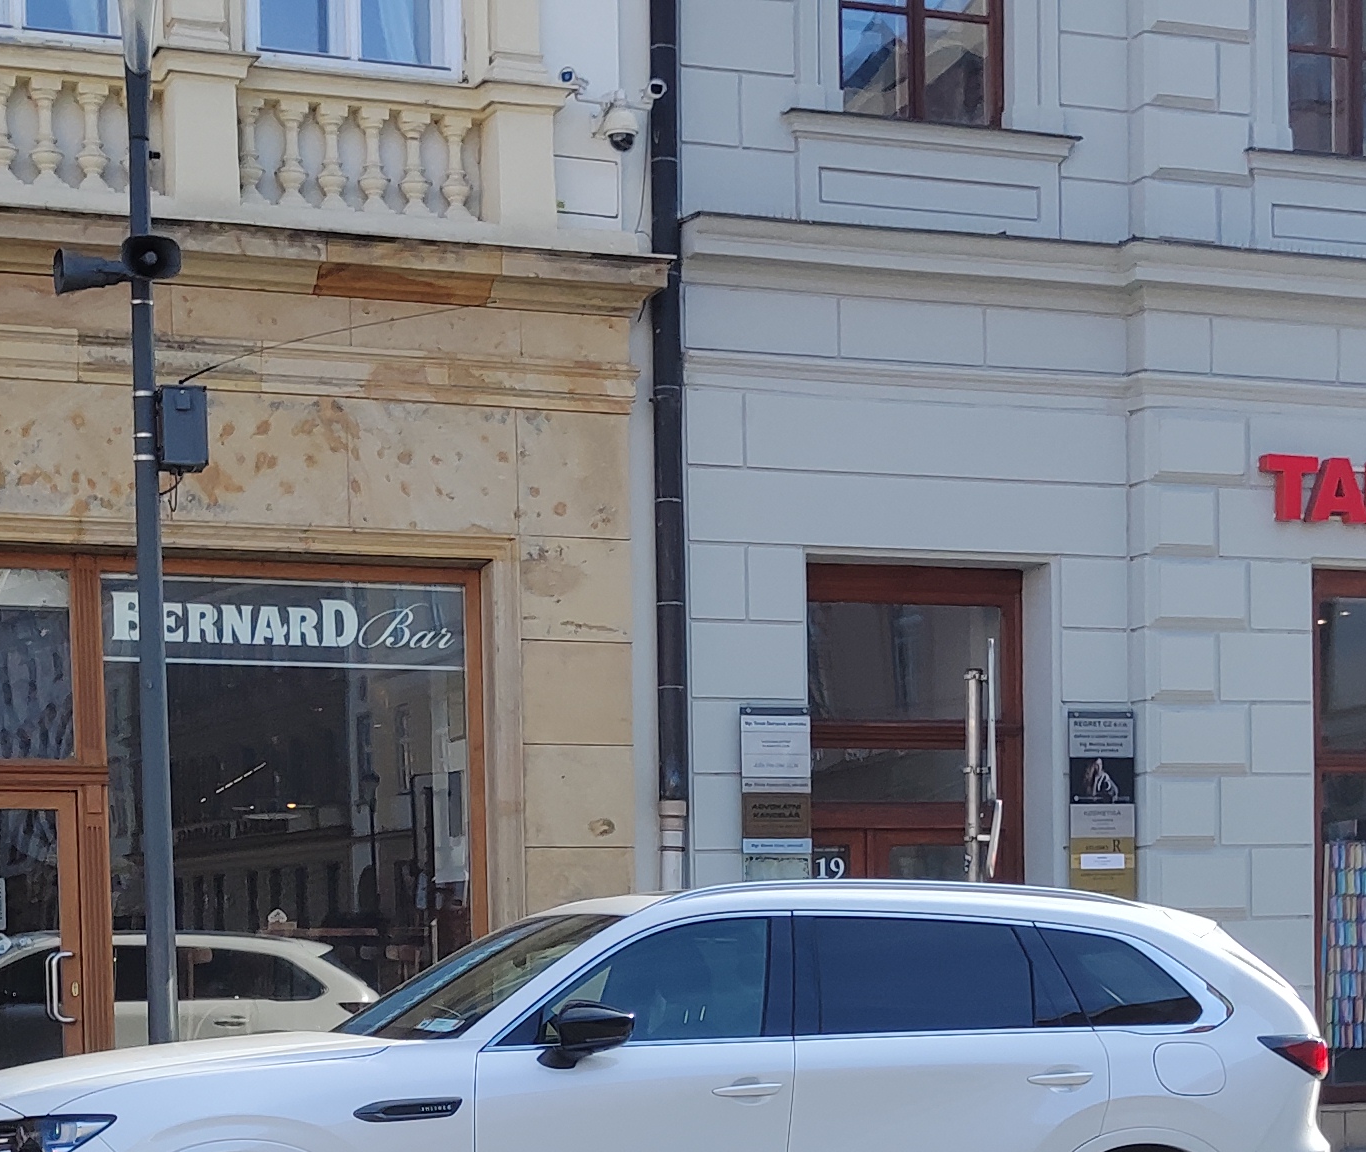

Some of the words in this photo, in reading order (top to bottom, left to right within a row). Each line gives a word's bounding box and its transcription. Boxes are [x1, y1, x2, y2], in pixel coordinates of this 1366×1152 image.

[111, 590, 360, 648] BERNARD
[357, 603, 456, 650] Bar
[815, 857, 845, 879] 19
